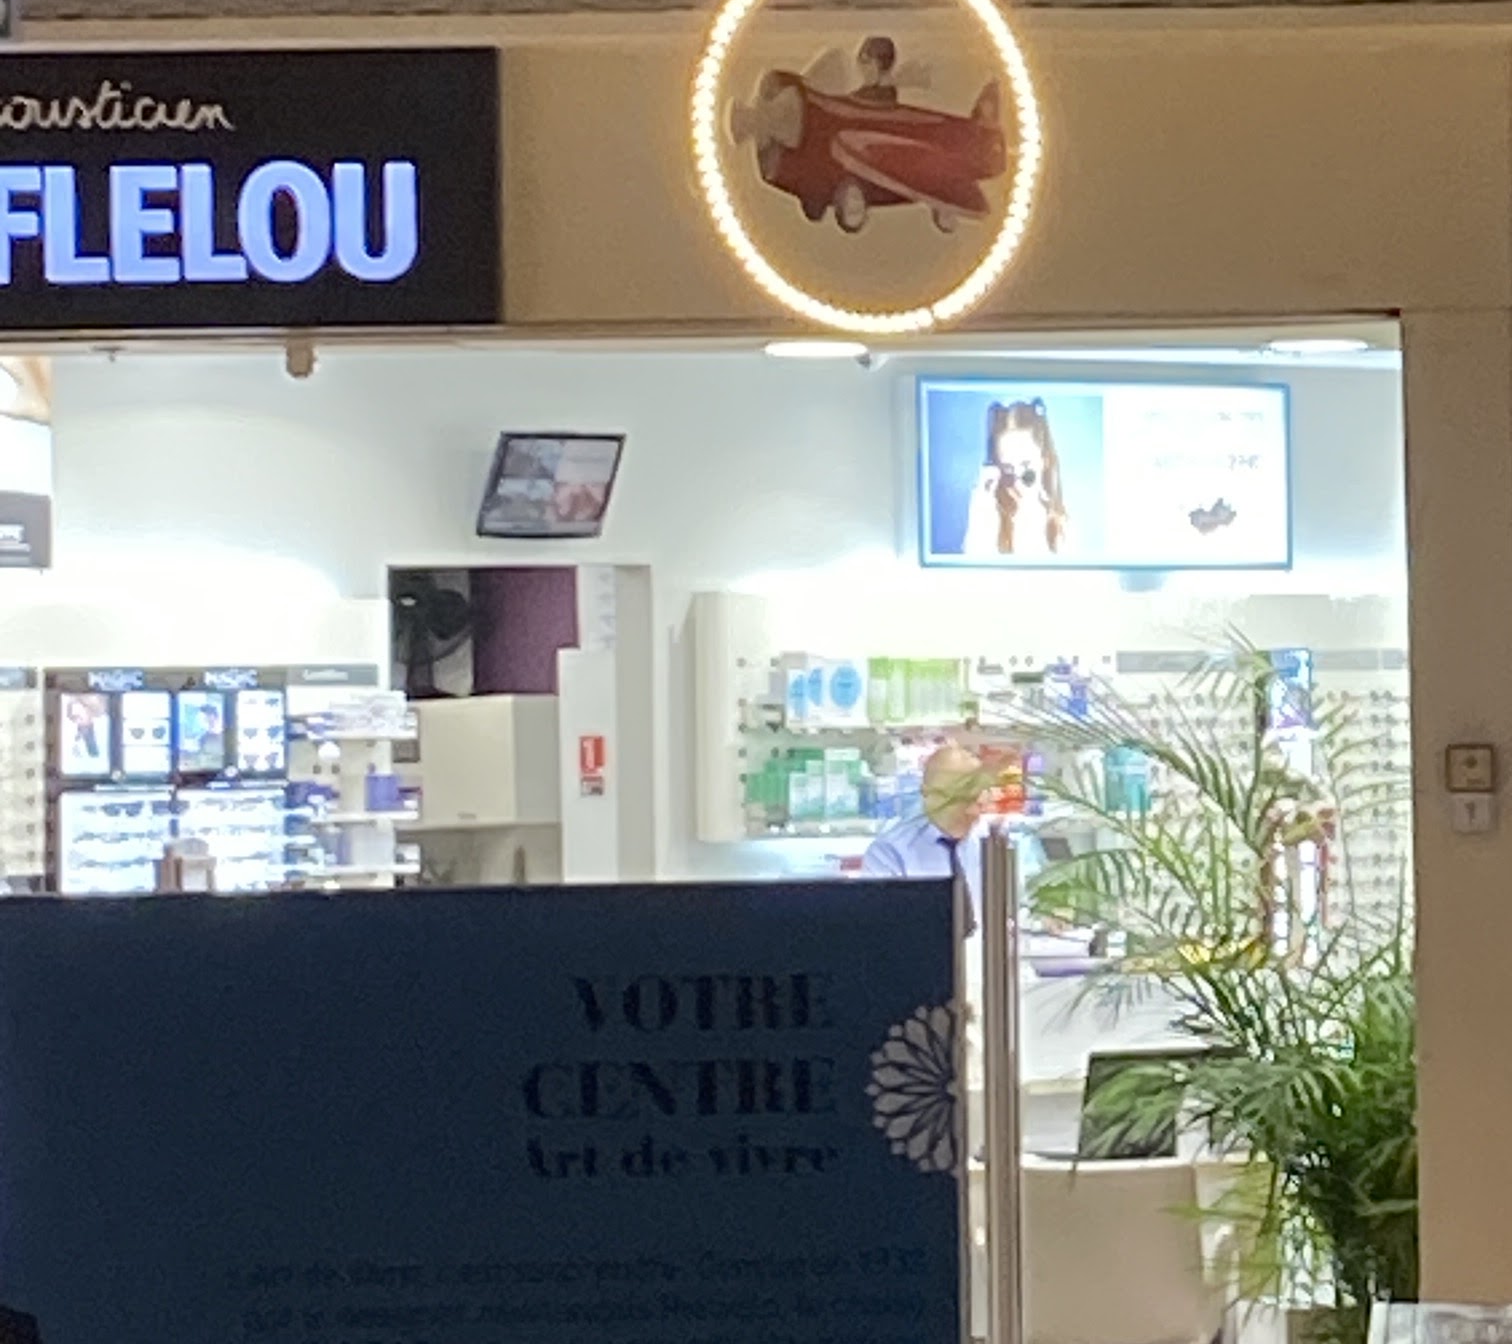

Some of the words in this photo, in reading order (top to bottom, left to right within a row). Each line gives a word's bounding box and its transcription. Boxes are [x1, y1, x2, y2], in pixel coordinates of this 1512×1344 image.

[569, 973, 834, 1032] VOTRE
[522, 1057, 838, 1119] CENTRE
[620, 1134, 687, 1177] de
[708, 1134, 838, 1175] vivre
